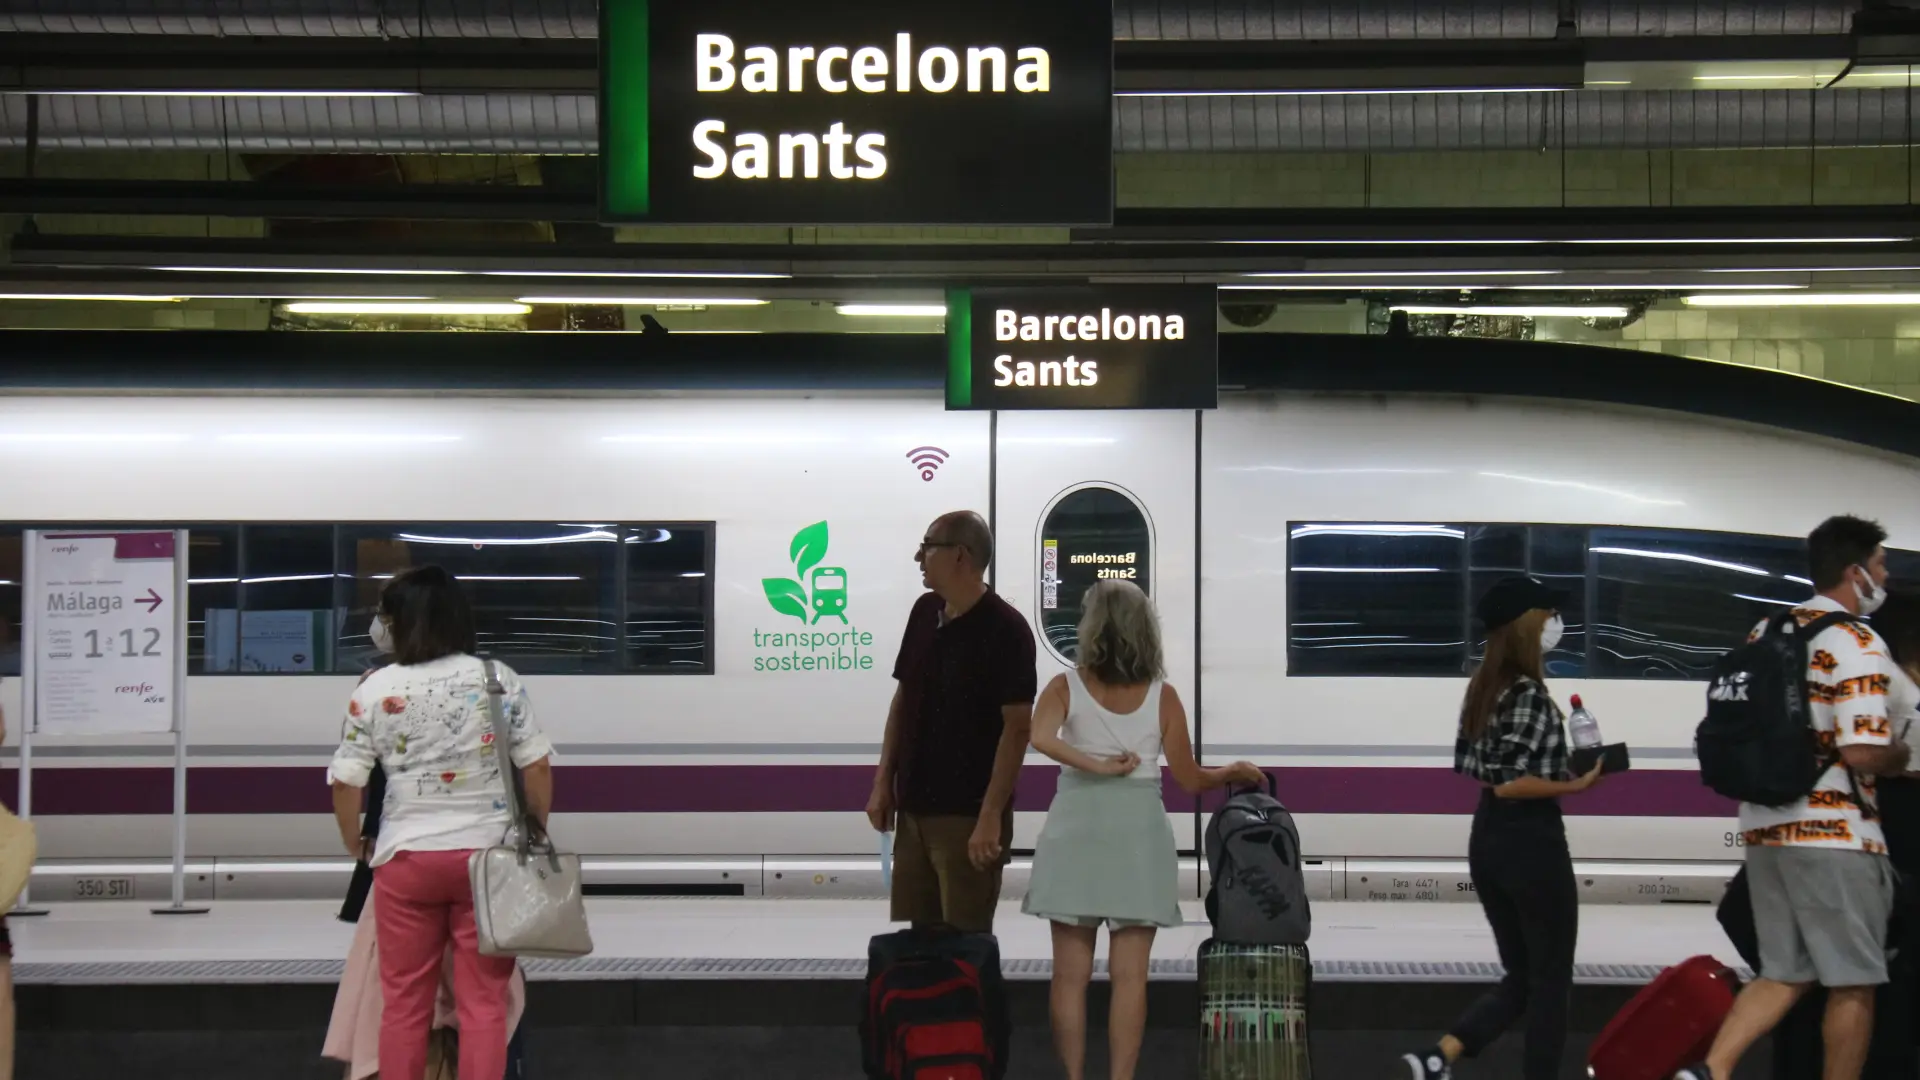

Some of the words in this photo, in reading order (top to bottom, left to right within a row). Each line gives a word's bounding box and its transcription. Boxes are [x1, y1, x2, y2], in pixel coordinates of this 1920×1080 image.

[696, 33, 1051, 93] Barcelona
[692, 119, 888, 180] Sants
[995, 307, 1185, 341] Barcelona
[993, 354, 1098, 387] Sants
[47, 591, 122, 614] Málaga
[84, 629, 103, 658] 1
[119, 627, 162, 657] 12
[753, 626, 873, 652] transporte
[753, 647, 873, 671] sostenible
[115, 682, 153, 696] renfe
[76, 880, 104, 896] 350
[108, 880, 130, 896] STI
